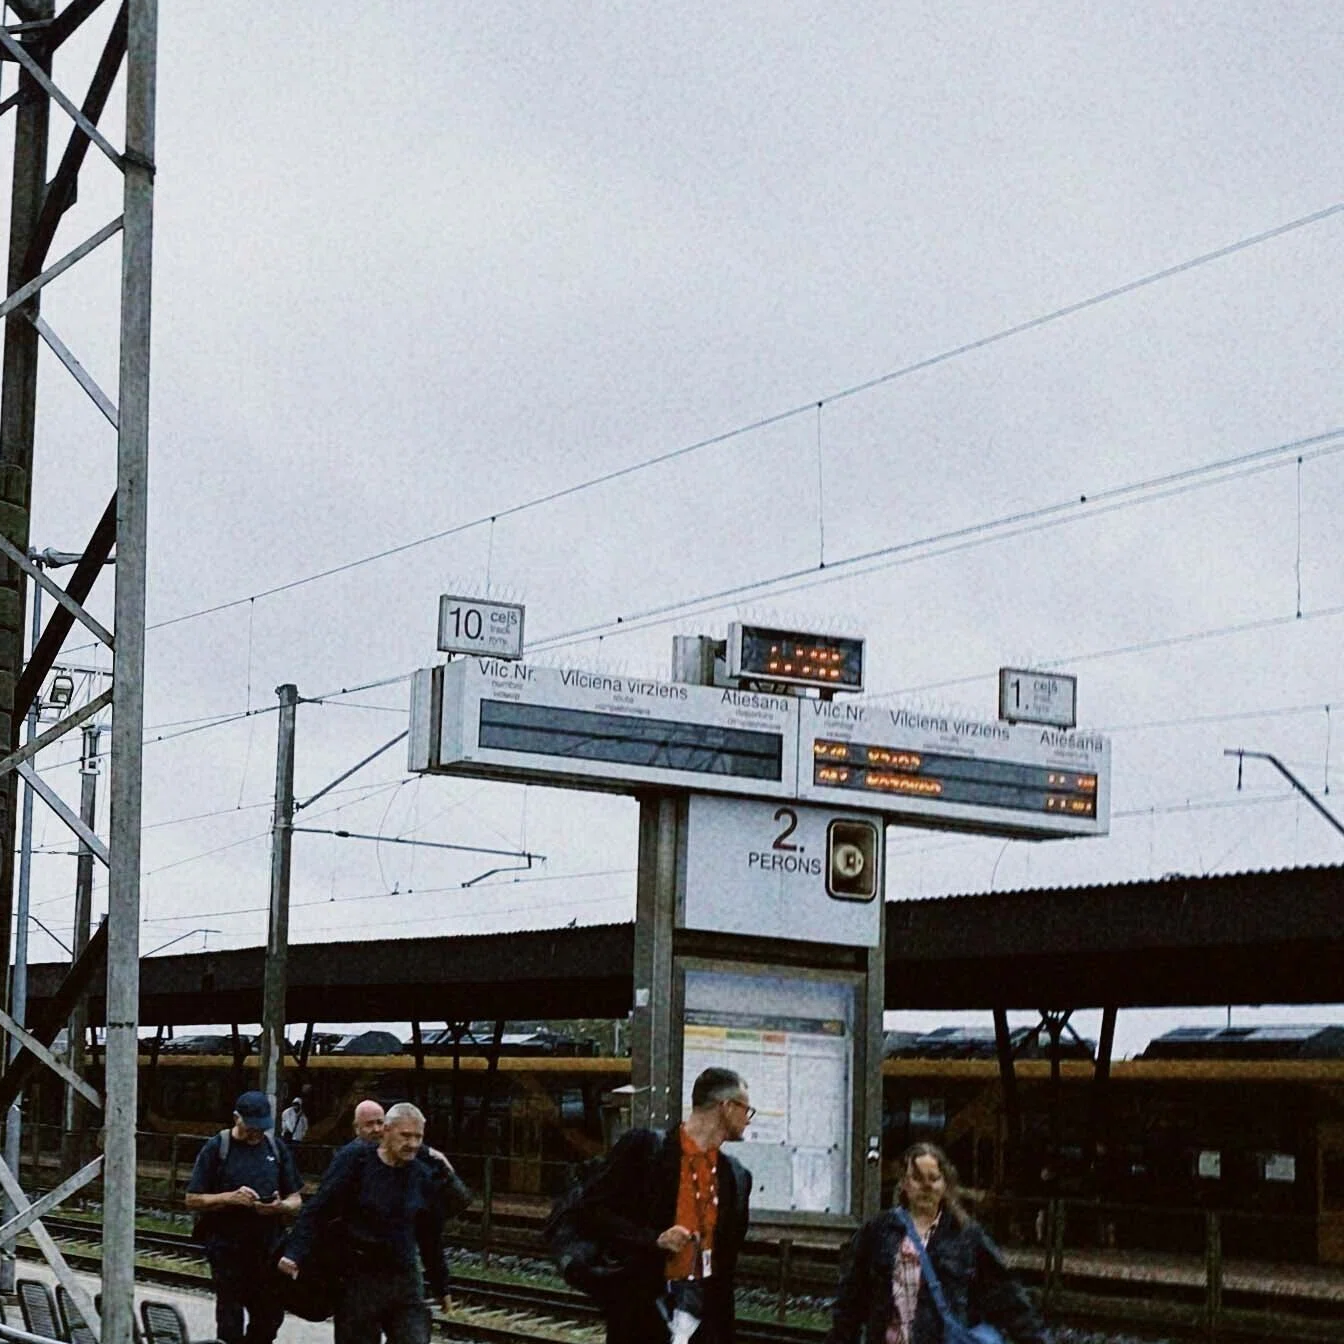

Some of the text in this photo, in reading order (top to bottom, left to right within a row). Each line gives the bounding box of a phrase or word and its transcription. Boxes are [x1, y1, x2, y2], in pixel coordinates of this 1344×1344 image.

[449, 607, 484, 641] 10.
[560, 669, 688, 700] Vilciena virziens
[1010, 678, 1029, 710] 1.
[890, 709, 948, 731] Vilciena
[953, 720, 1010, 741] virziens
[772, 807, 805, 853] 2.
[748, 852, 822, 875] PERONS
